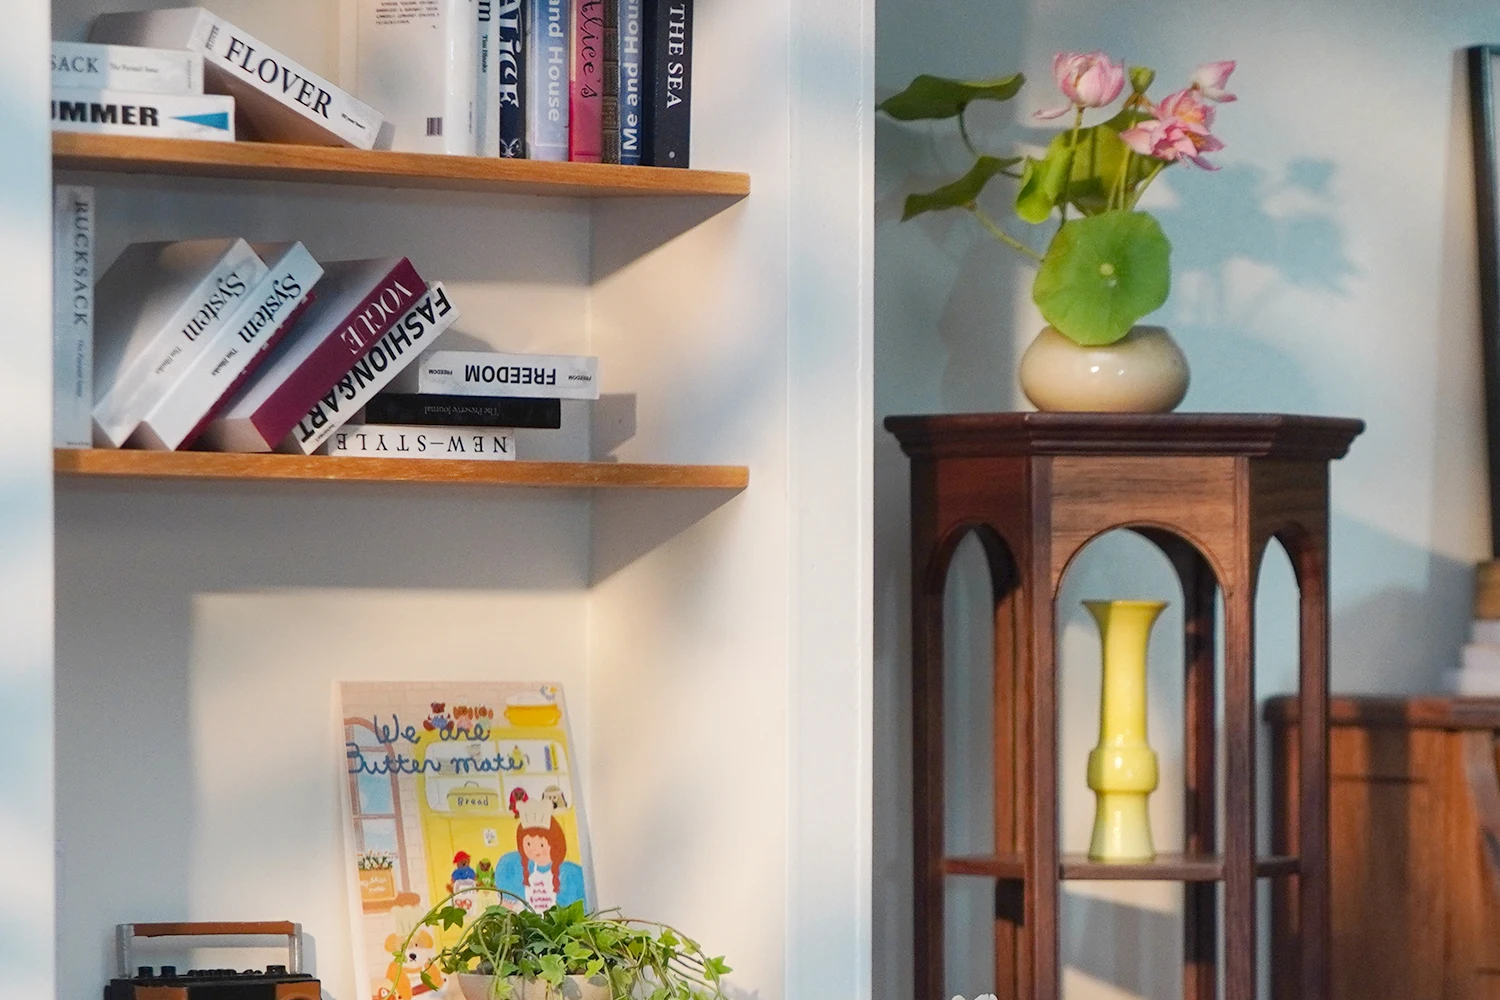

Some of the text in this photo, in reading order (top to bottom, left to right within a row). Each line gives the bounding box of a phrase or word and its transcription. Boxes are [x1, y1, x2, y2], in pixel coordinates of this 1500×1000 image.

[224, 35, 333, 120] FLOVER
[548, 46, 563, 122] House
[623, 62, 639, 106] and
[666, 3, 686, 109] THE SEA
[623, 114, 638, 151] Me
[73, 199, 89, 326] RUCKSACK
[181, 271, 247, 343] System
[237, 272, 302, 345] System
[340, 279, 414, 356] VOGUE
[464, 363, 557, 386] FREEDOM
[346, 741, 524, 775] Butter mate
[373, 713, 490, 745] We are
[457, 796, 489, 807] Bread
